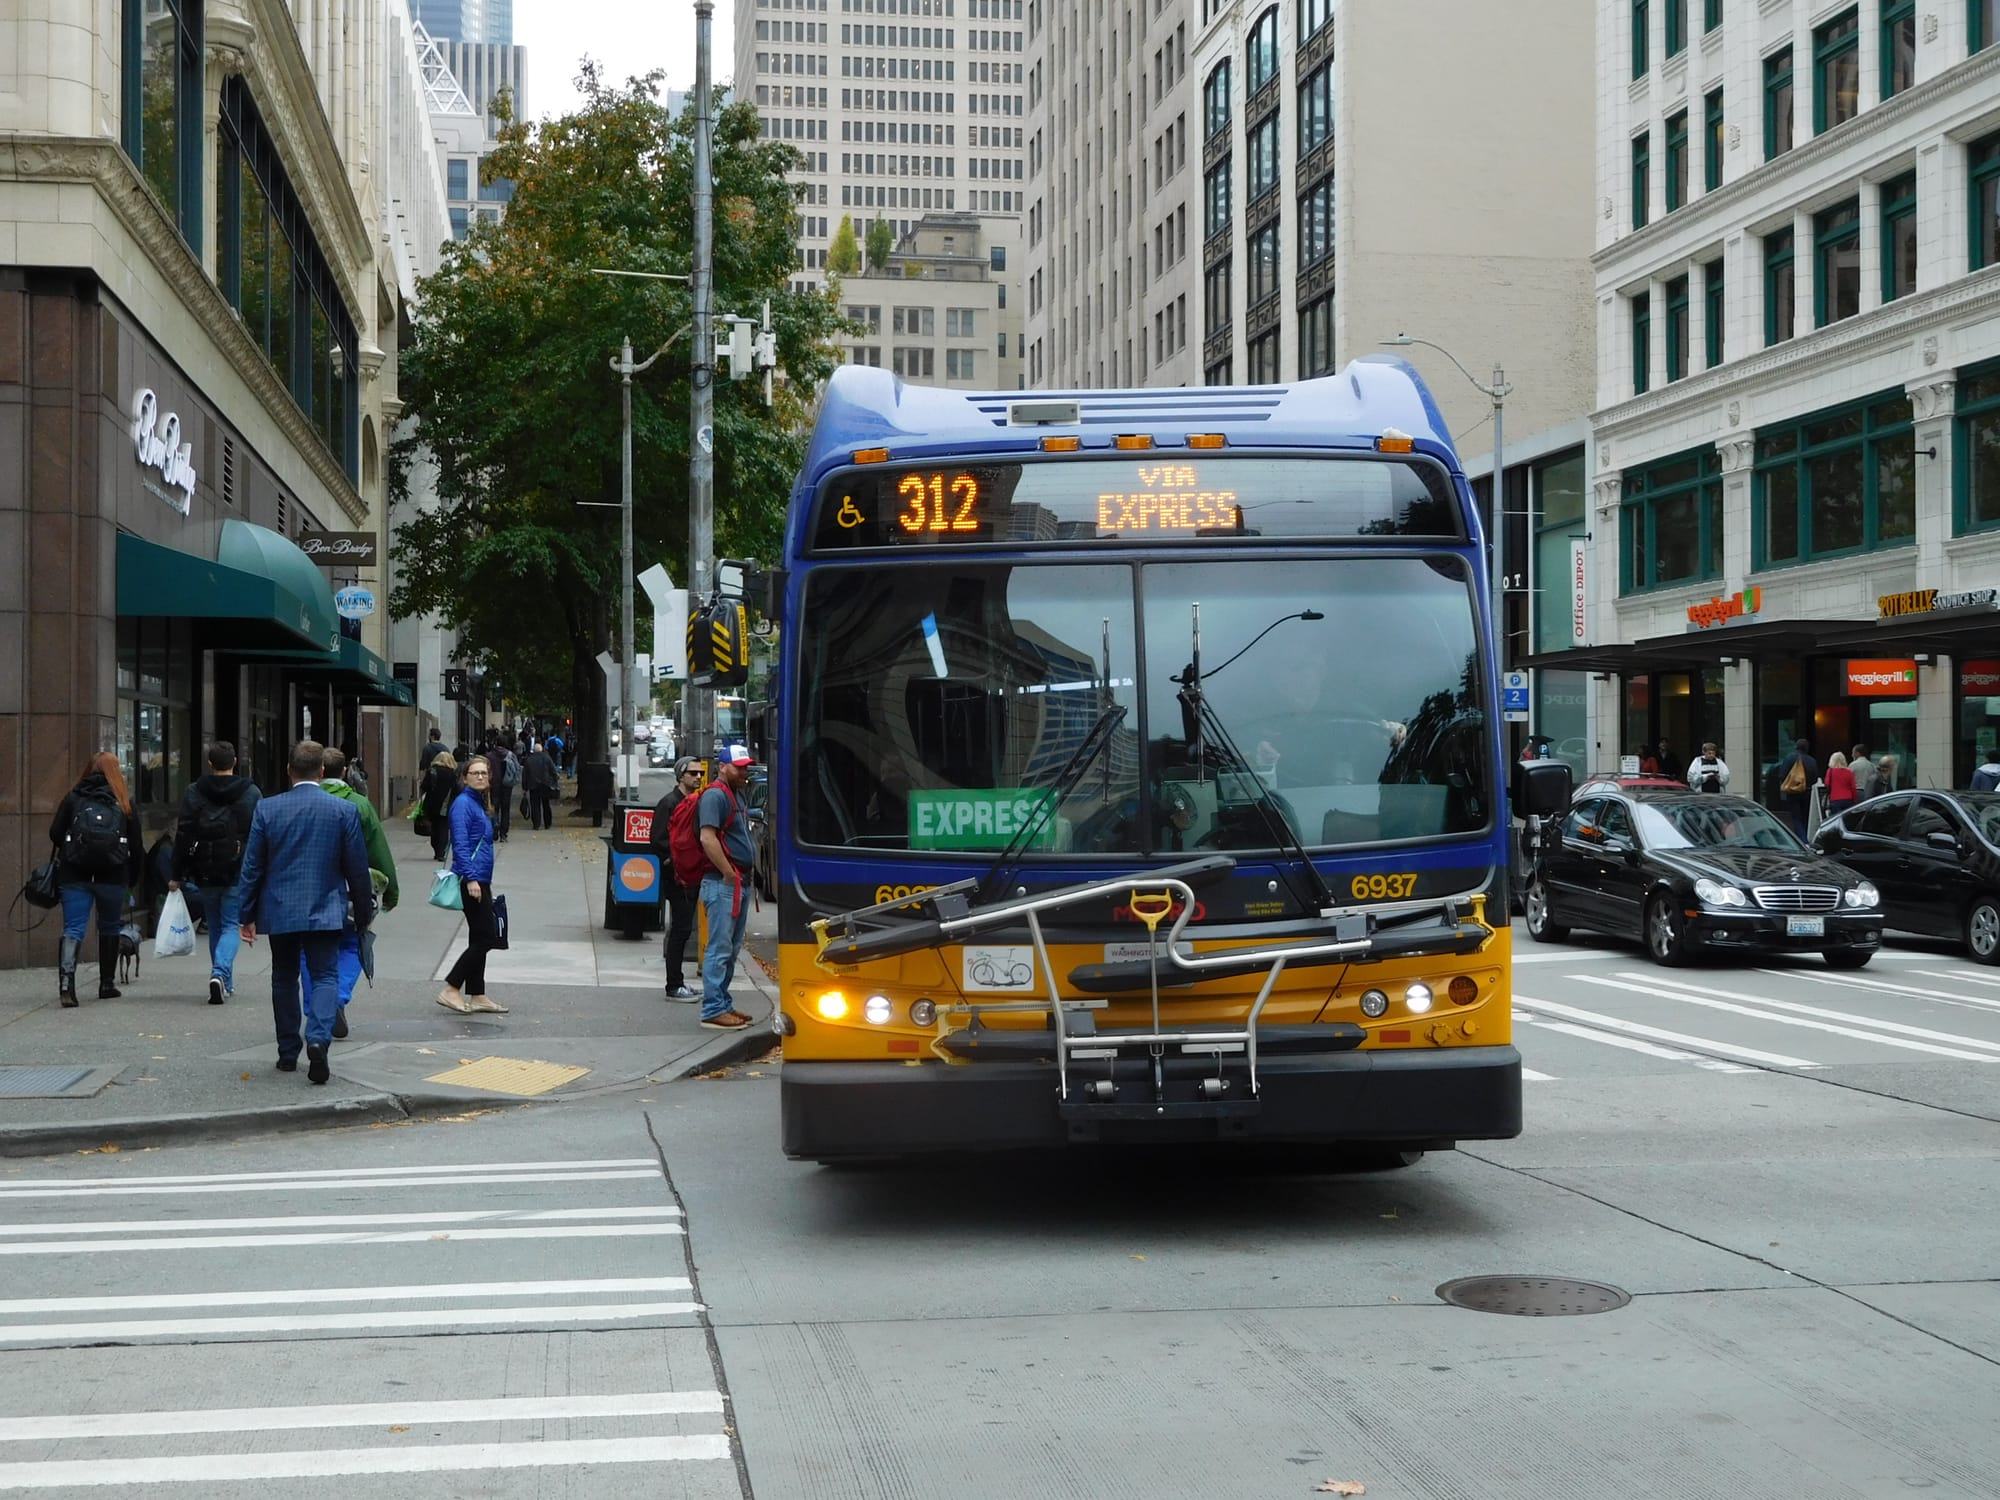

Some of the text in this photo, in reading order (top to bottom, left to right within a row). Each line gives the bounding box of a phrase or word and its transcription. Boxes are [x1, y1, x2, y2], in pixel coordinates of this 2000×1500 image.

[1138, 466, 1196, 487] VIA
[899, 474, 979, 531] 312
[1098, 492, 1237, 529] EXPRESS
[304, 538, 374, 557] Ben Bridge
[336, 596, 373, 610] WALKING
[1575, 550, 1584, 638] Office DEPOT
[1879, 589, 1994, 617] POTBELLY SANDWICH SHOP
[452, 675, 460, 685] C
[1849, 671, 1903, 686] veggiegrill
[451, 685, 460, 693] W
[1512, 690, 1520, 701] 2
[630, 814, 653, 830] City
[916, 799, 1050, 837] EXPRESS
[629, 826, 650, 839] Arts
[1351, 873, 1418, 899] 6937
[875, 885, 942, 910] 693
